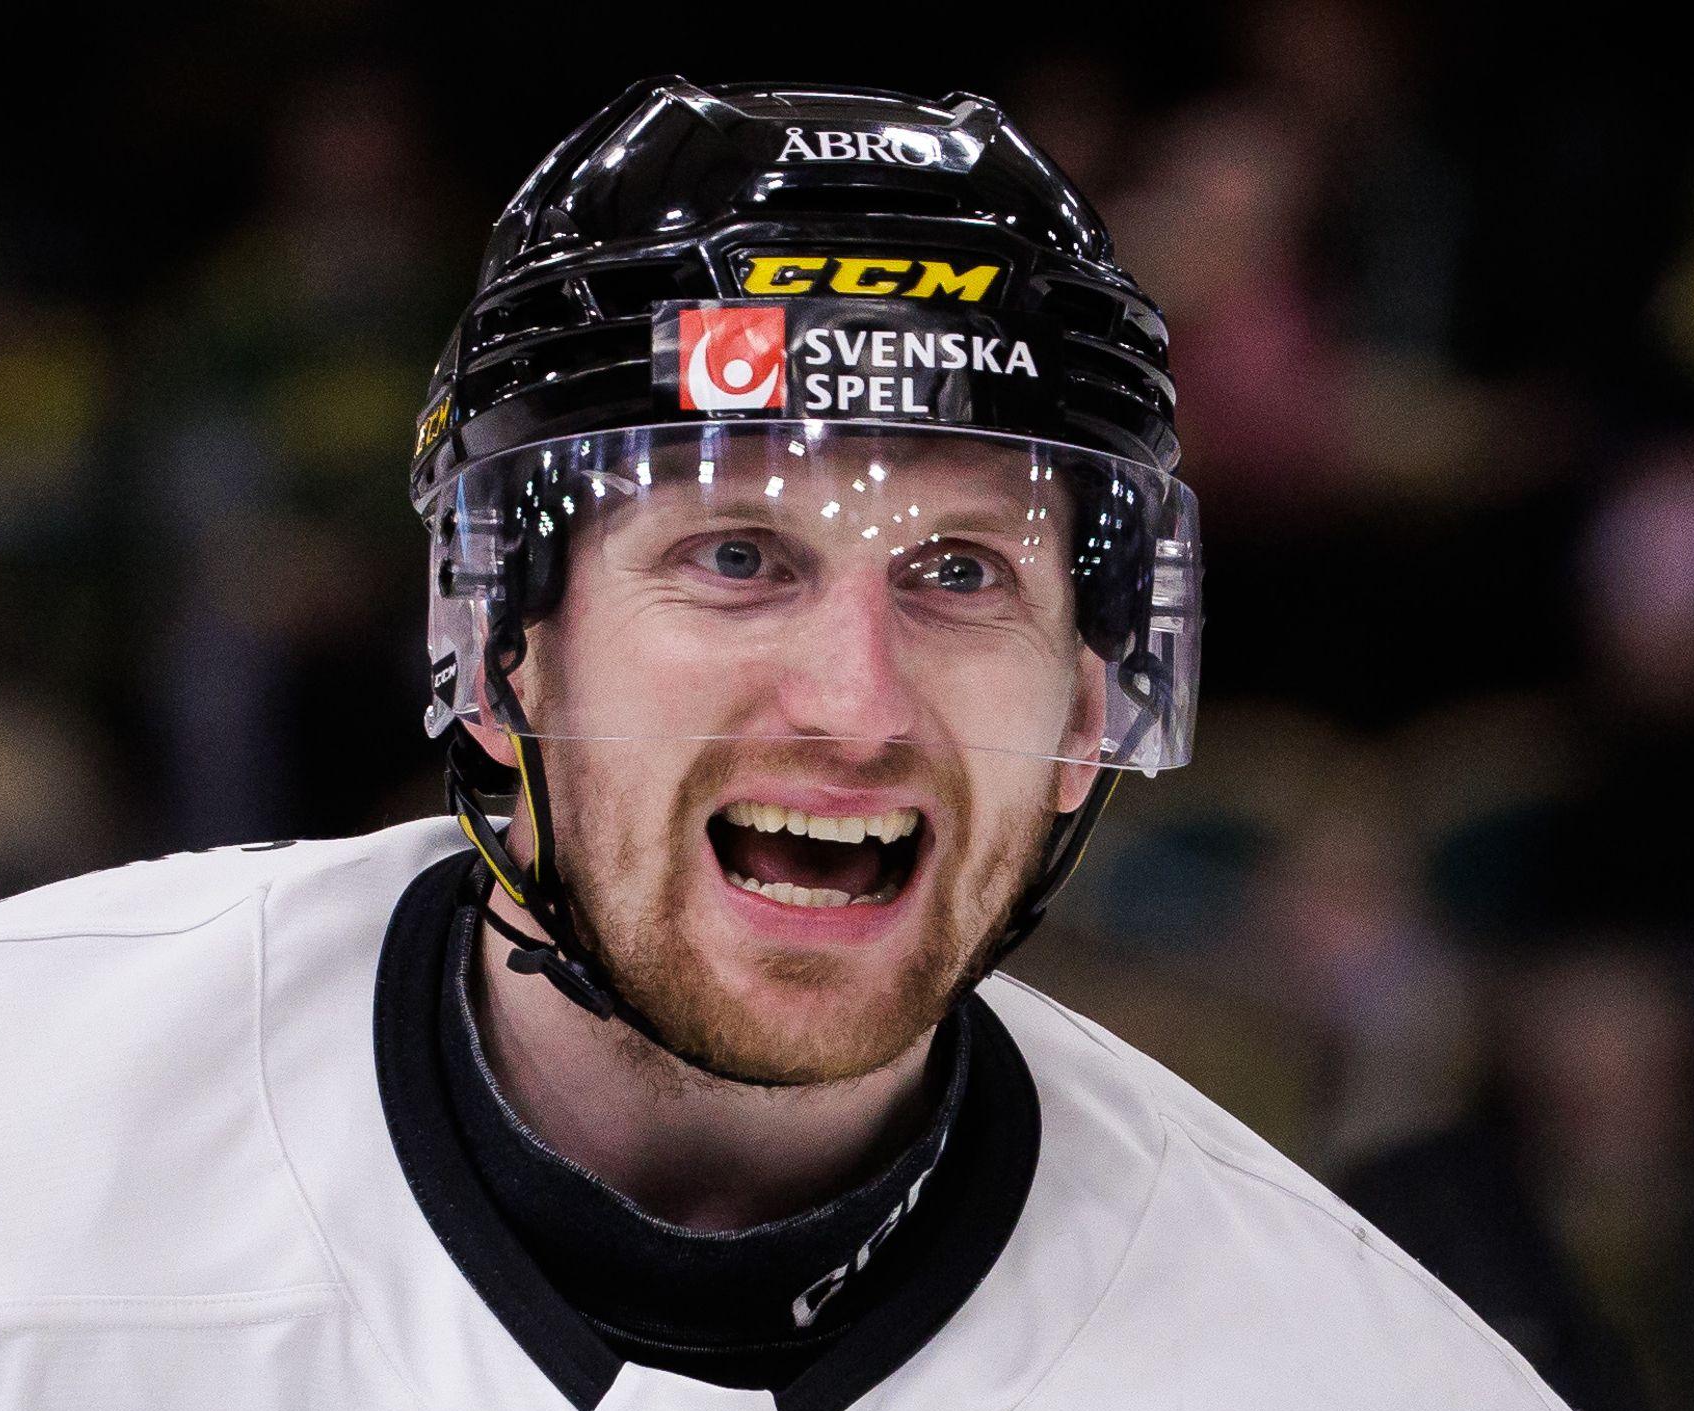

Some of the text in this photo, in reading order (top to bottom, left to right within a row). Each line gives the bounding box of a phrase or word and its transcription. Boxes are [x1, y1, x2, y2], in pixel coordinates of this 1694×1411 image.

[775, 127, 940, 166] ÅBRO
[743, 257, 1000, 301] CCM
[804, 328, 1039, 377] SVENSKA
[804, 373, 930, 414] SPEL
